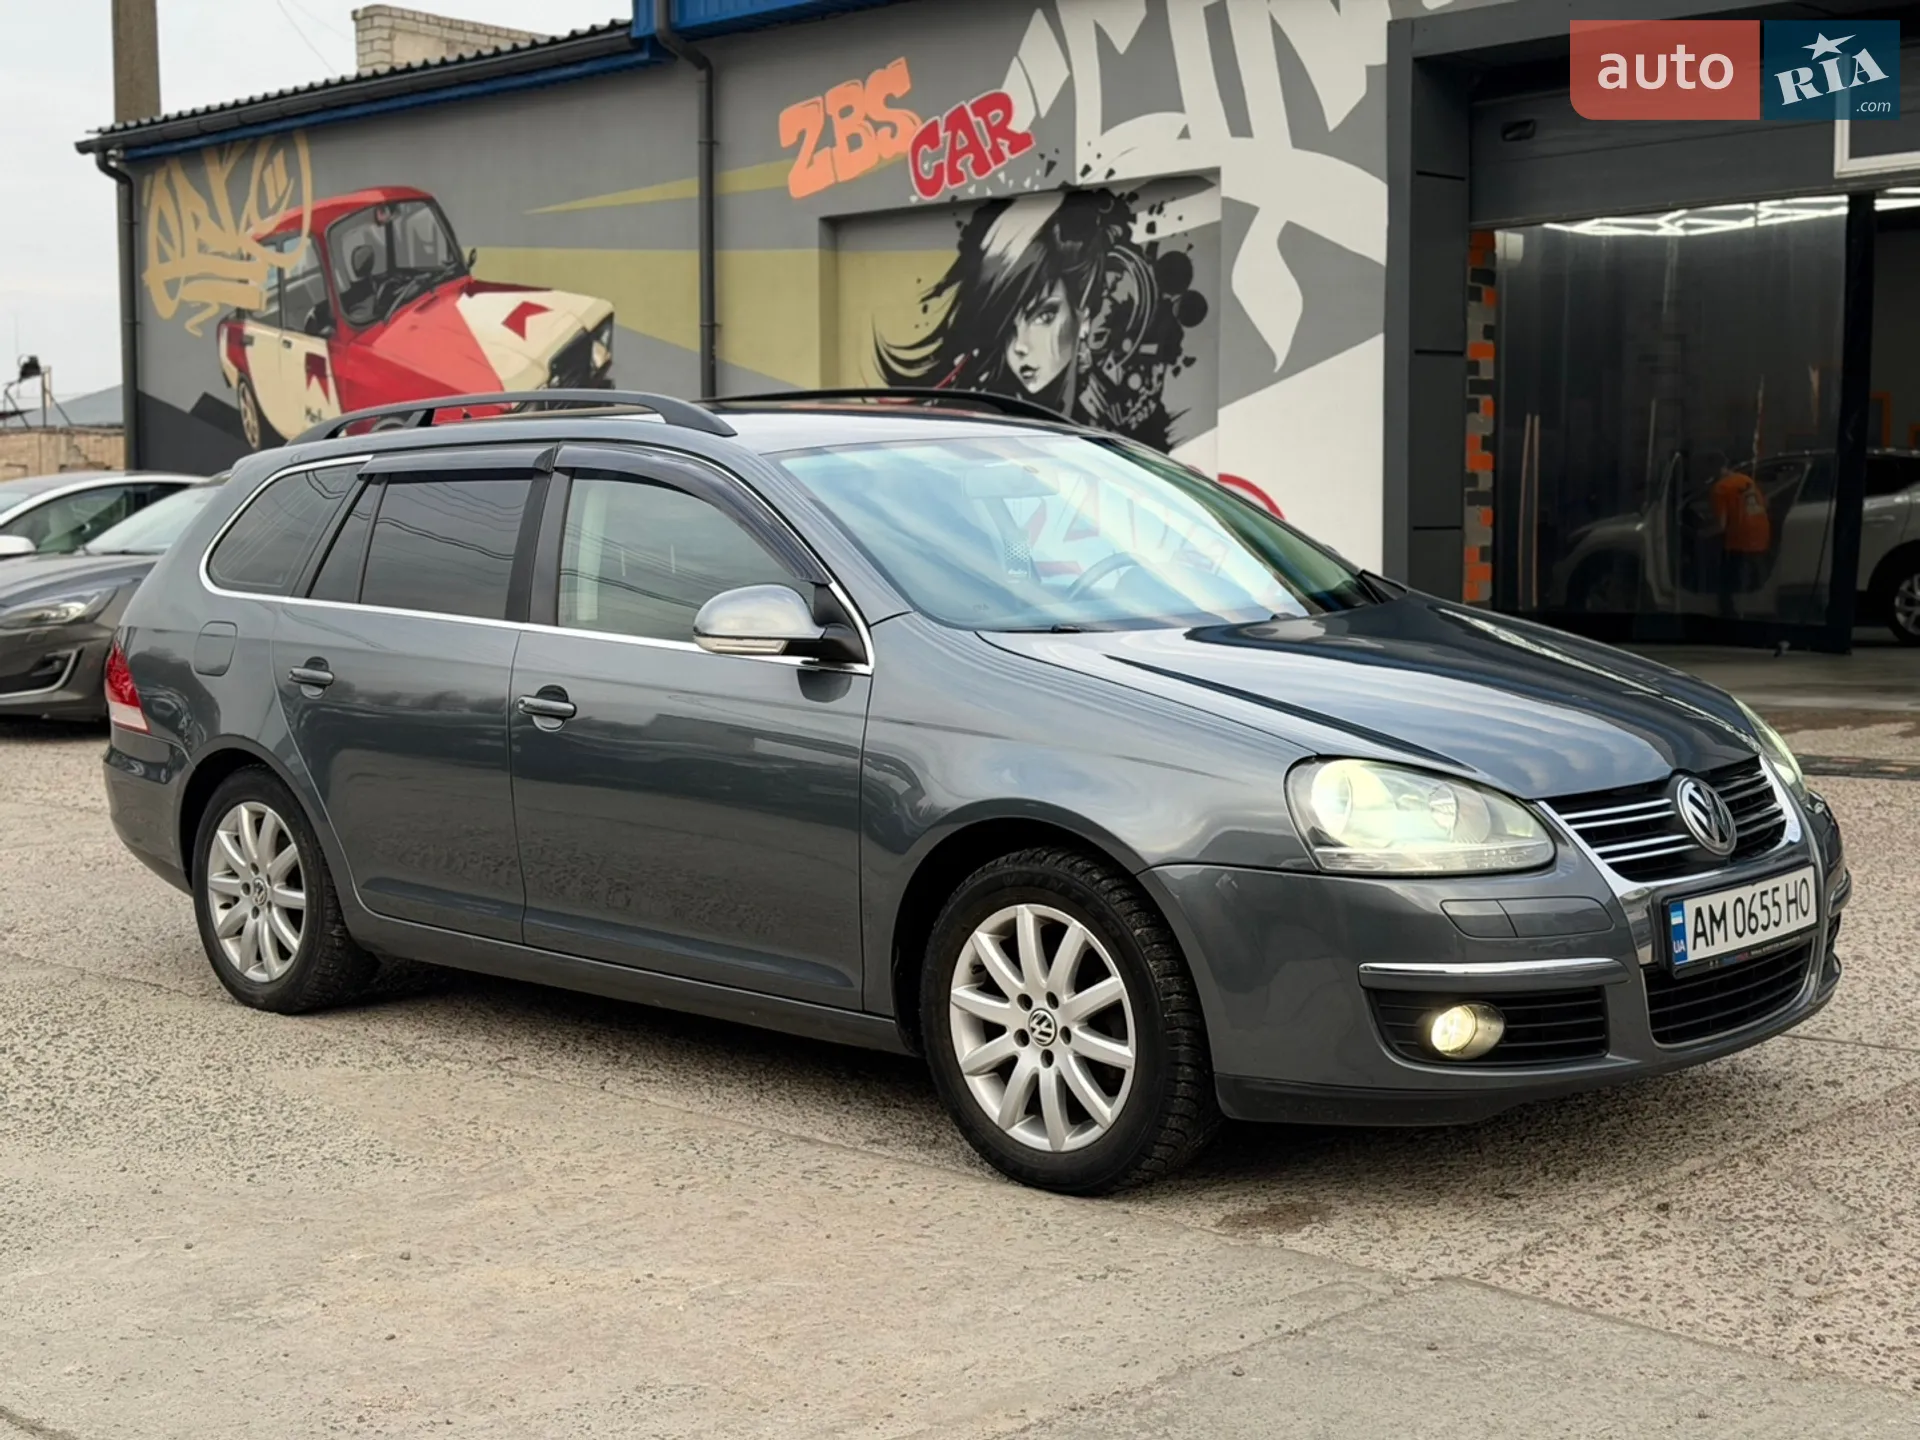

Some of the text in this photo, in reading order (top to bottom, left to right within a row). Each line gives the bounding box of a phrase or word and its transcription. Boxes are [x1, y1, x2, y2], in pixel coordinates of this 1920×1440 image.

[779, 56, 922, 199] ZBS
[908, 88, 1036, 200] CAR
[1673, 940, 1686, 954] UA
[1692, 877, 1811, 951] AM 0655 HO
